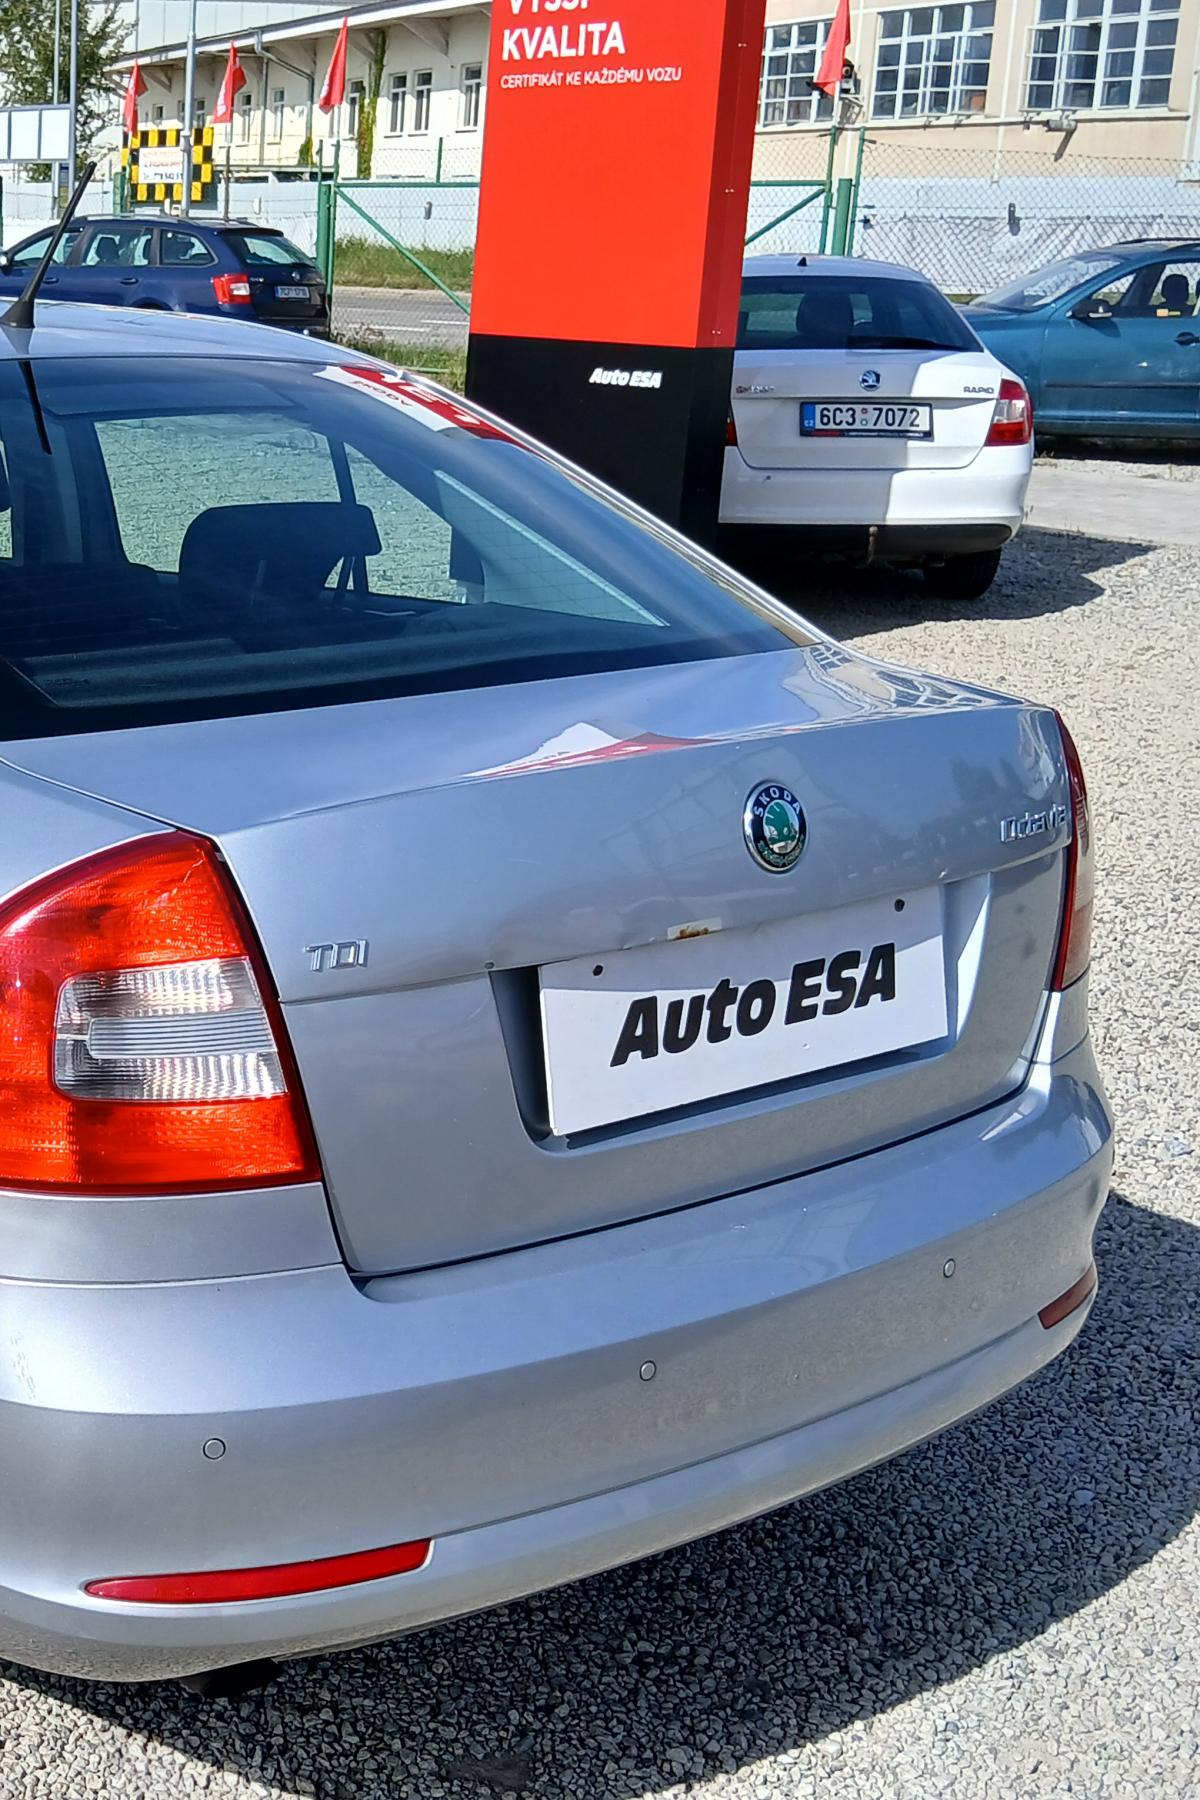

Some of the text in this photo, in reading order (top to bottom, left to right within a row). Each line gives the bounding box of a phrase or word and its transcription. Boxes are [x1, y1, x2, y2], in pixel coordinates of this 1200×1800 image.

[502, 21, 626, 61] KVALITA
[500, 67, 682, 89] CERTIFIKÁT KE KAŽDÉMU VOZU
[588, 367, 663, 389] Auto ESA
[820, 407, 921, 427] 6C3 7072
[304, 939, 368, 972] TDI
[610, 942, 894, 1068] Auto ESA
